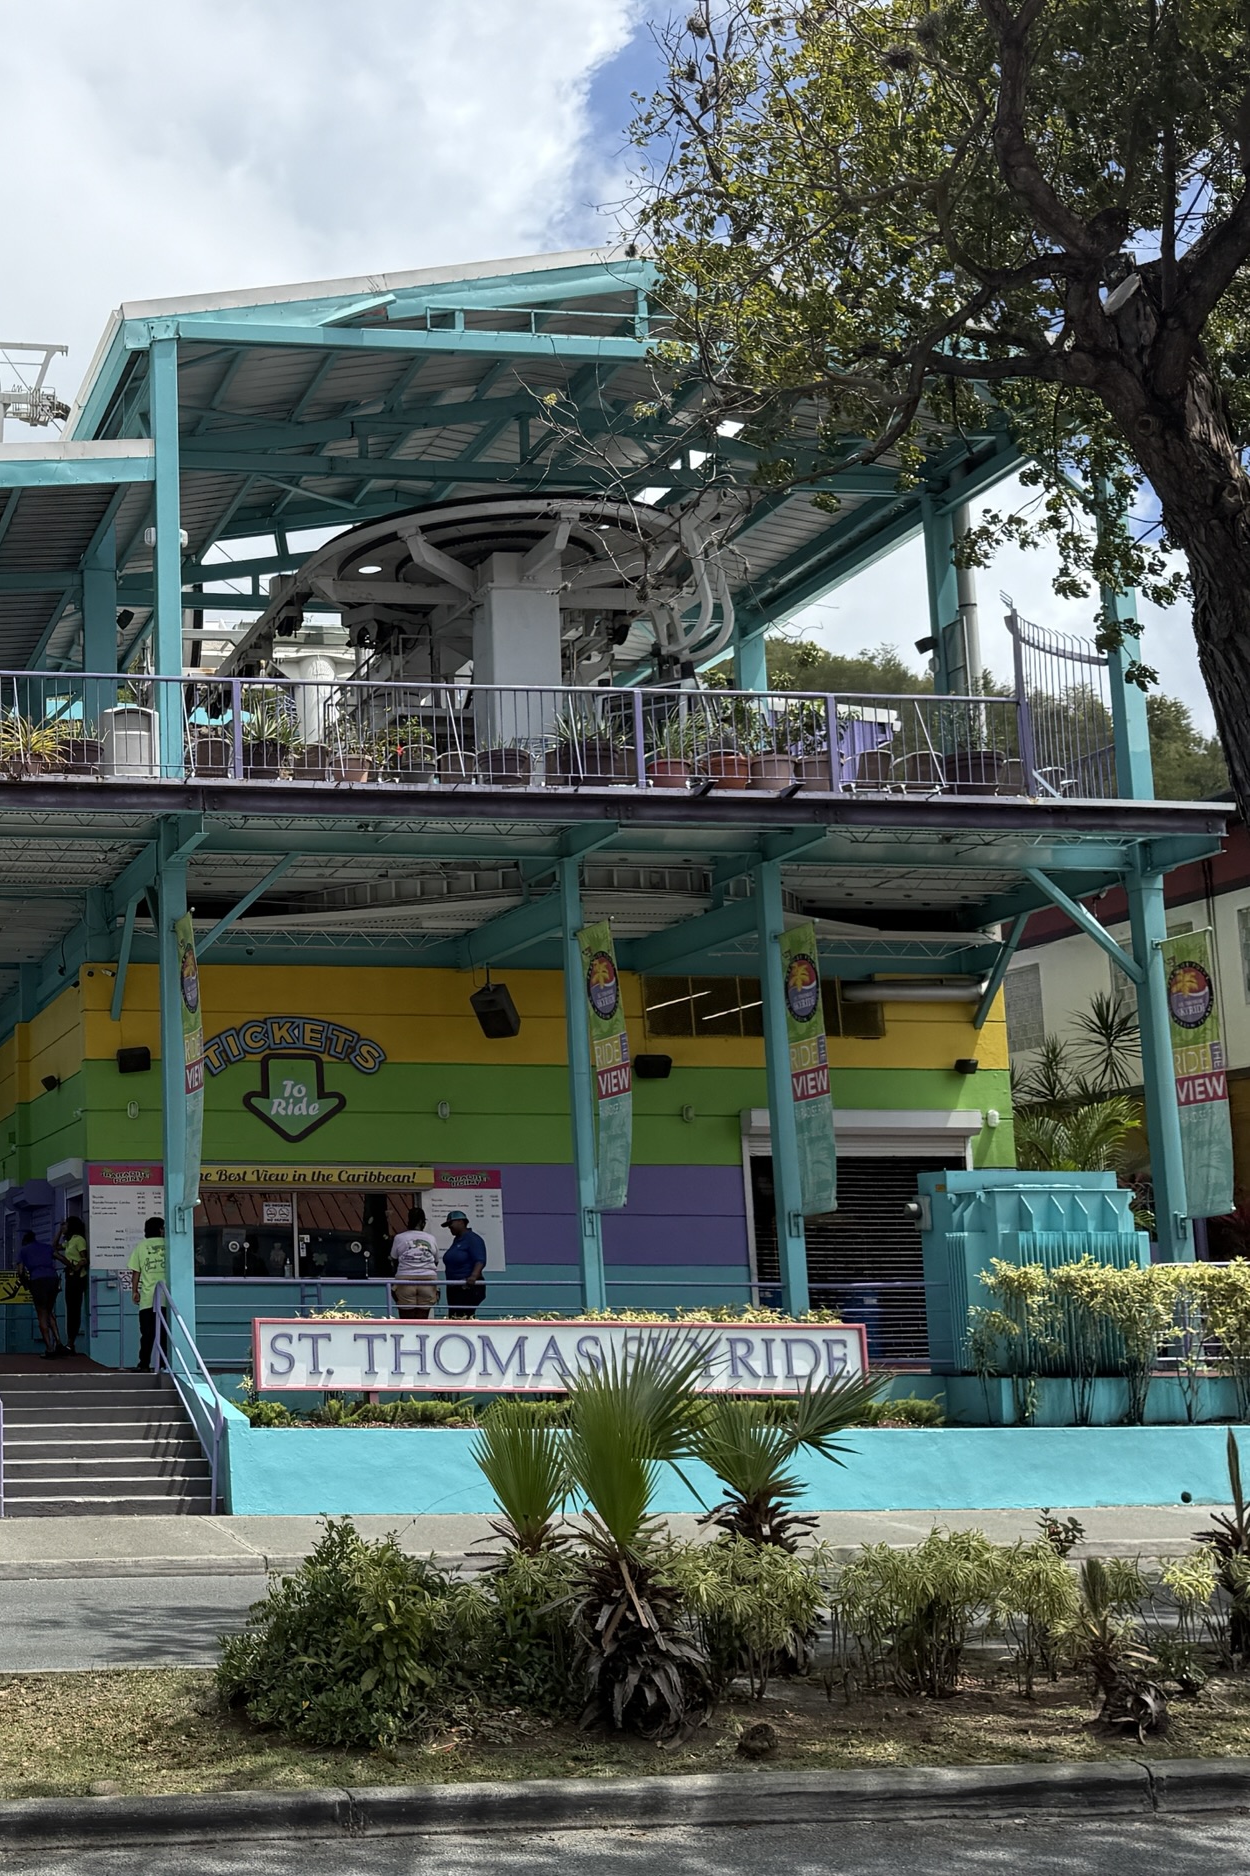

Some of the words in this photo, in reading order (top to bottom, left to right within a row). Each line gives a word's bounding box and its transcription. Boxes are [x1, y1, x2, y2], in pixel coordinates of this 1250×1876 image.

[204, 1016, 387, 1077] TICKETS
[595, 1040, 621, 1067] RIDE
[790, 1042, 818, 1069] RIDE
[1212, 1045, 1222, 1069] THE
[1174, 1048, 1209, 1074] RIDE
[282, 1080, 307, 1099] To
[598, 1067, 630, 1096] VIEW
[792, 1069, 828, 1098] VIEW
[1177, 1075, 1225, 1103] VIEW
[270, 1099, 320, 1116] Ride
[216, 1169, 248, 1182] Best
[251, 1169, 289, 1182] View
[292, 1170, 307, 1183] in
[310, 1170, 333, 1183] the
[337, 1170, 417, 1184] Caribbean!
[269, 1332, 335, 1376] ST.
[353, 1332, 602, 1379] THOMAS
